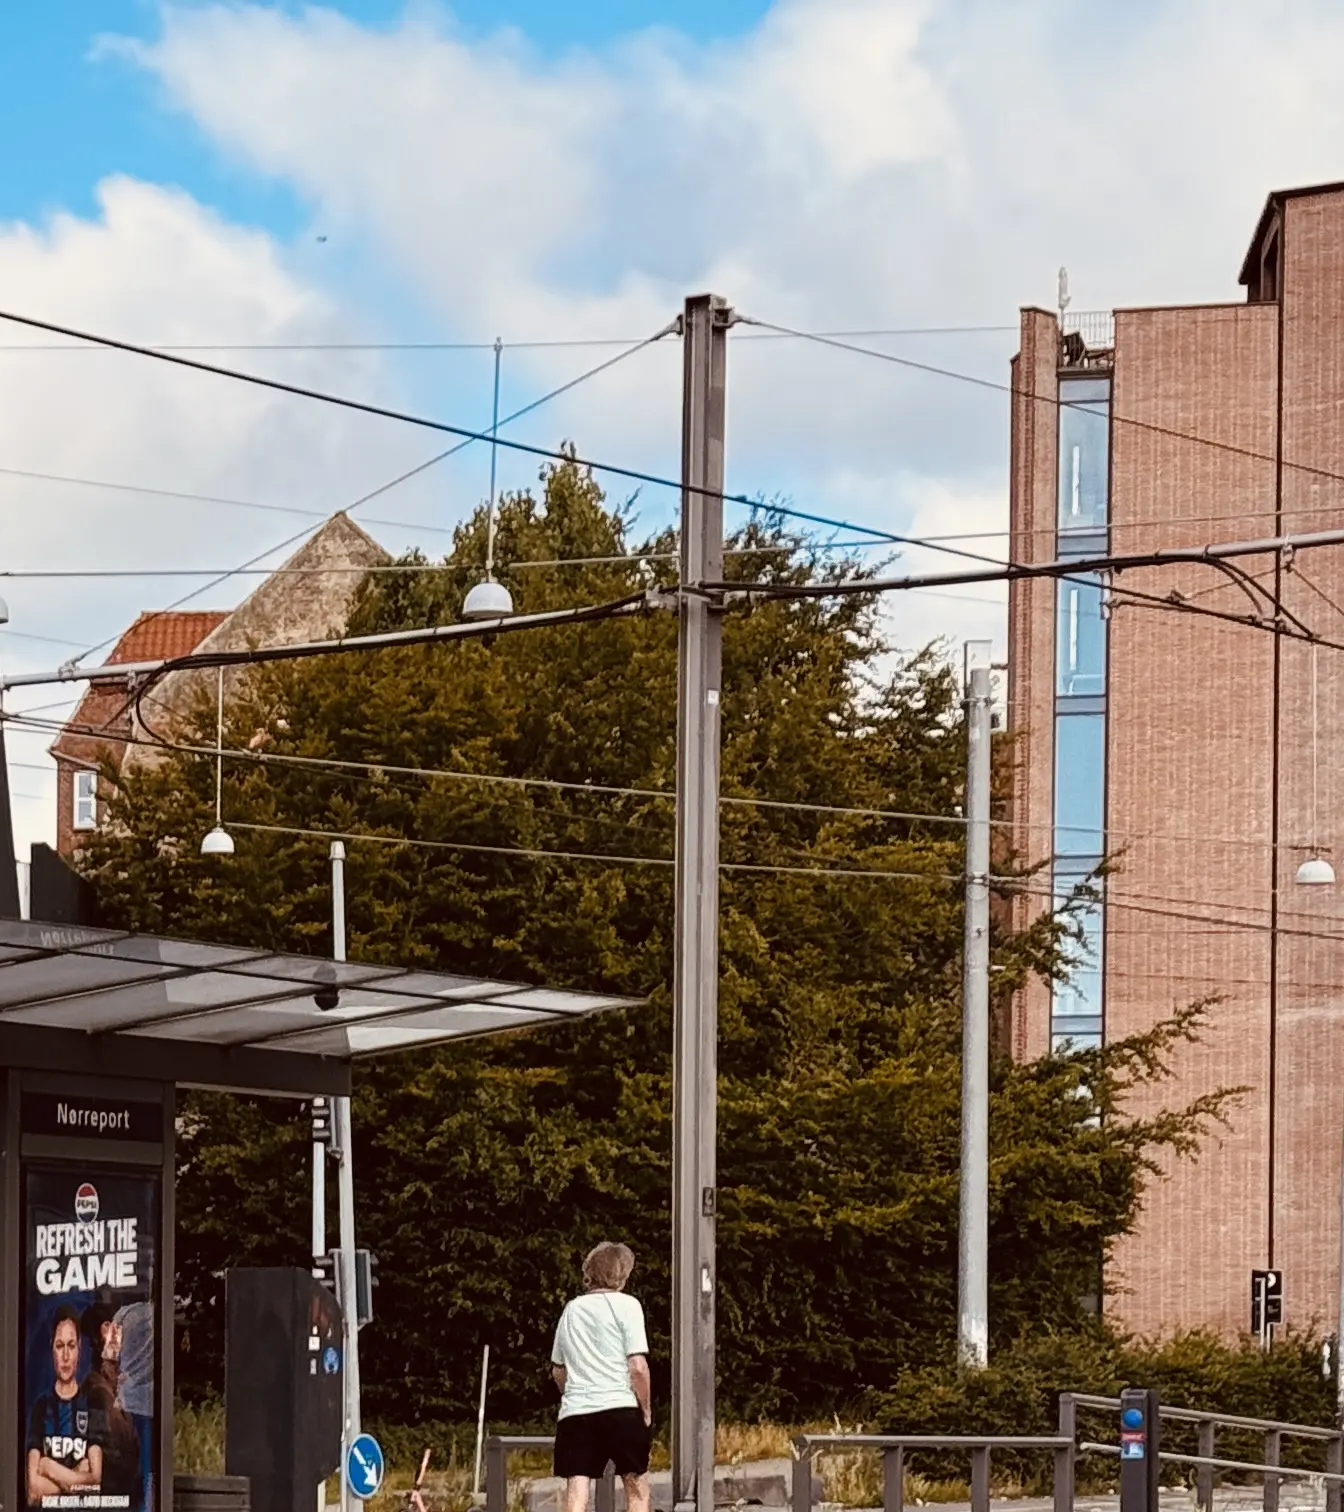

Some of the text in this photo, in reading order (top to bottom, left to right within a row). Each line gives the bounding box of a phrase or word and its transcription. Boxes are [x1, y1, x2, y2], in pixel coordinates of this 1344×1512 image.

[57, 1103, 130, 1132] Nørreport
[36, 1217, 138, 1258] REFRESH THE
[36, 1252, 138, 1295] GAME
